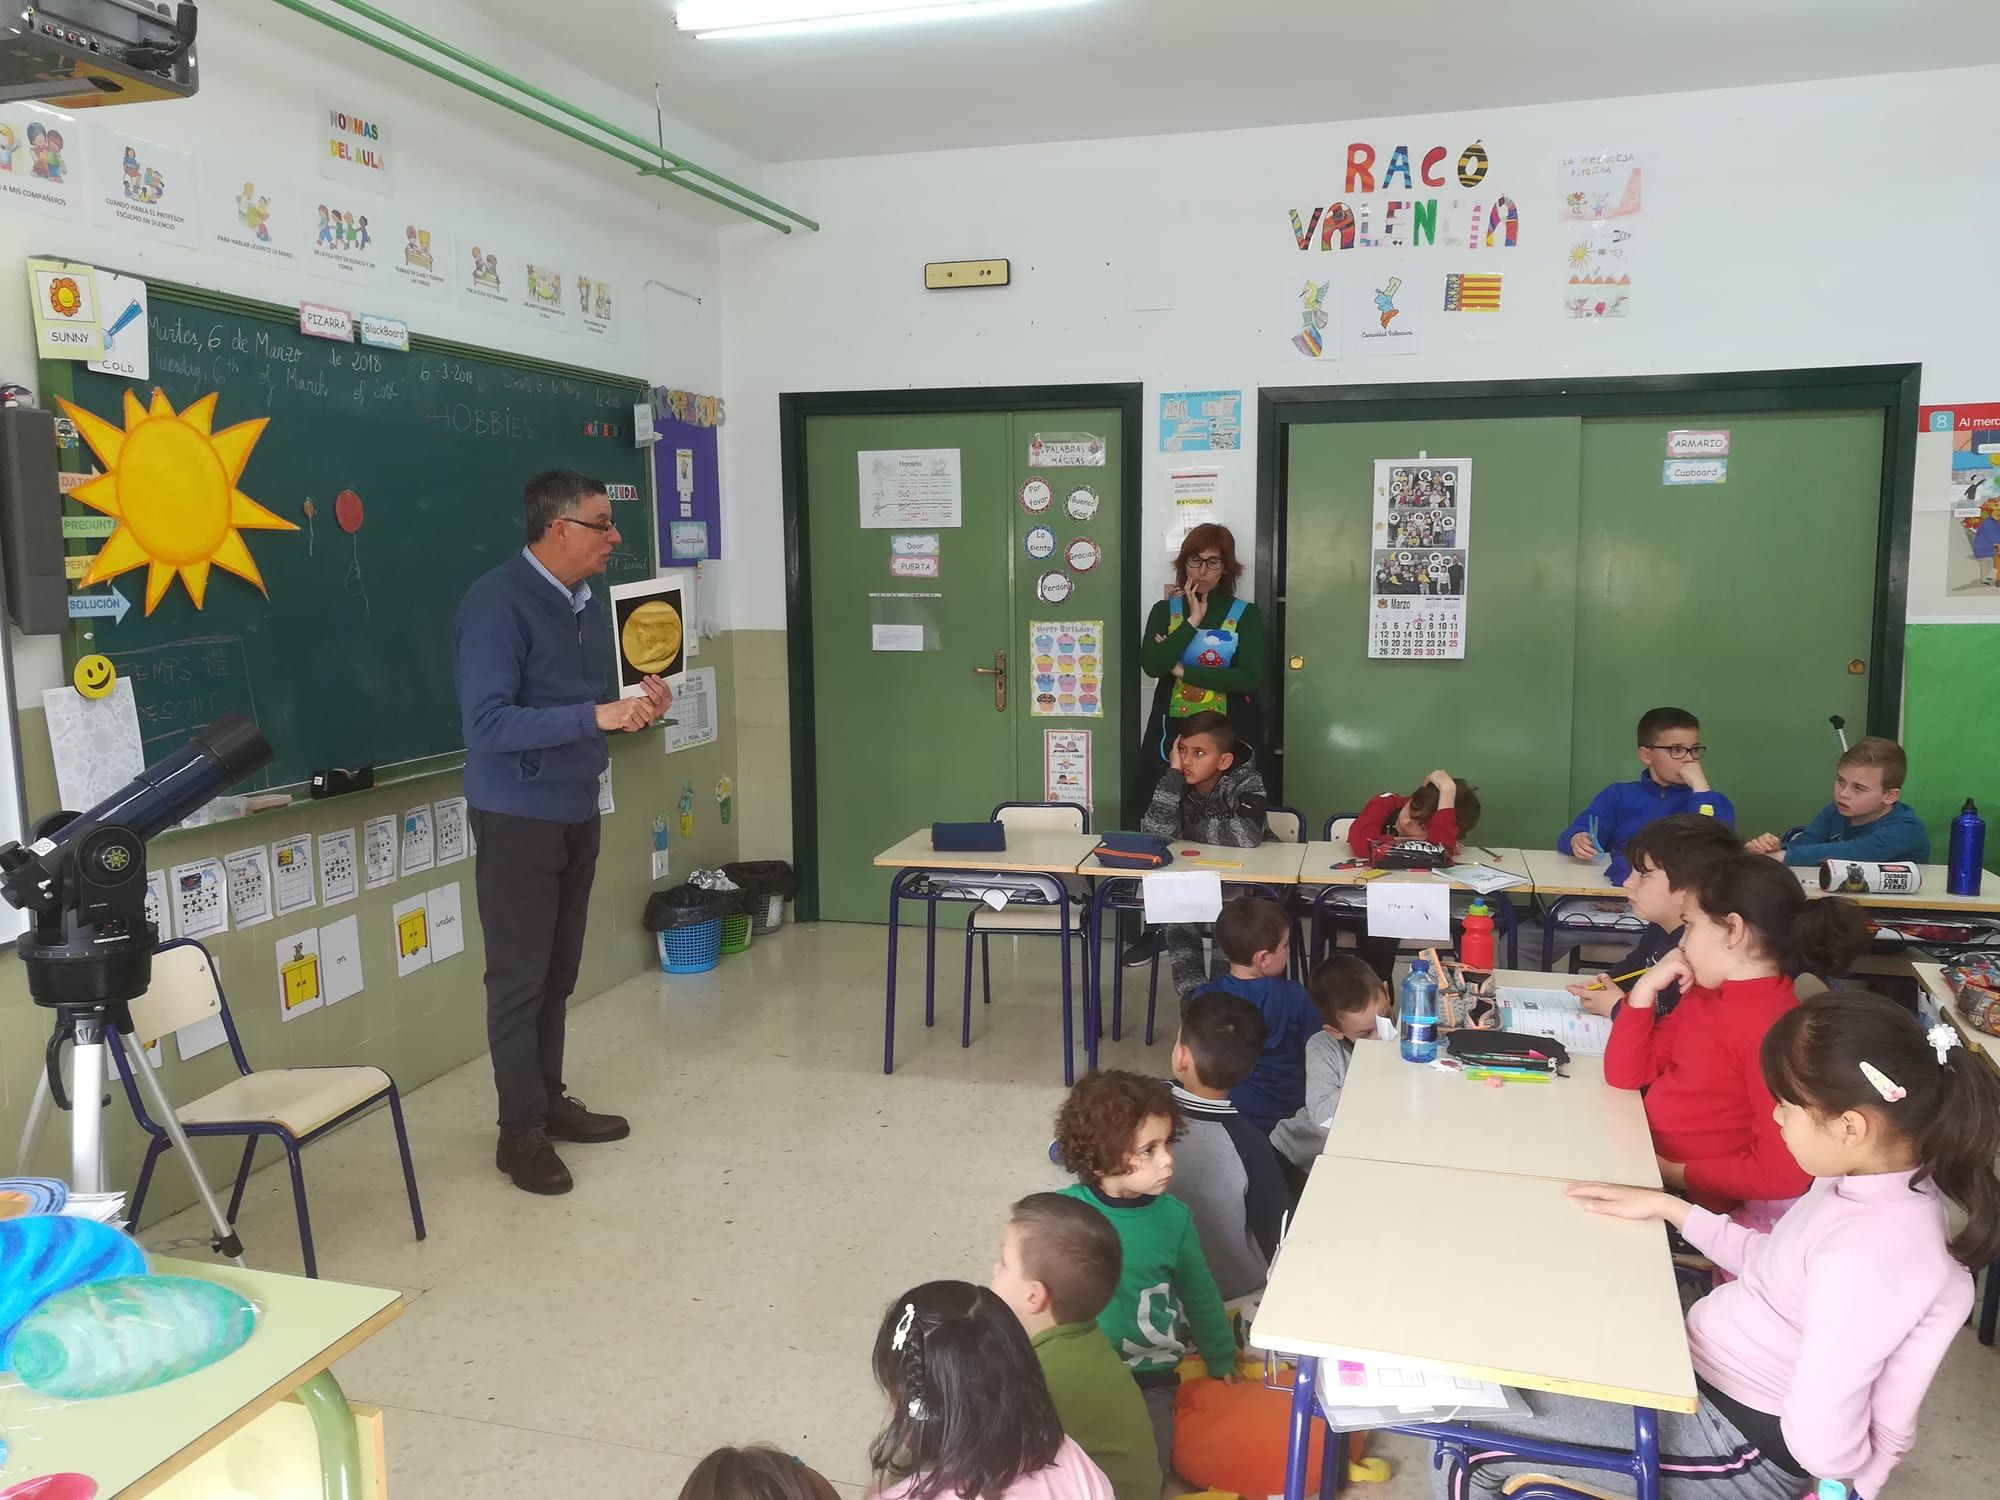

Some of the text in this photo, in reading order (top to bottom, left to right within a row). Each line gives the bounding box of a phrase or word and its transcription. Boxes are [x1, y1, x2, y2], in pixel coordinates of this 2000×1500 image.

[329, 110, 378, 141] NORMAS
[329, 139, 385, 172] DEL AULA
[1345, 138, 1488, 193] RACÓ
[9, 186, 22, 195] MIS
[22, 189, 67, 206] COMPAÑEROS
[105, 197, 130, 210] CUANDO
[130, 203, 149, 215] HABLA
[156, 211, 184, 224] PROFESOR
[116, 210, 175, 231] ESCUCHO EN SILENCIO
[217, 235, 231, 244] PARA
[250, 243, 272, 254] LEVANTO
[307, 312, 346, 330] PIZARRA
[51, 331, 89, 343] SUNNY
[365, 323, 405, 340] BlackBoard
[207, 324, 223, 351] 6
[232, 328, 249, 353] de
[255, 332, 303, 362] Marzo
[351, 351, 382, 373] 2018
[103, 360, 134, 373] COLD
[424, 400, 536, 438] HOBBIES
[1936, 414, 1948, 429] 8
[1958, 417, 1971, 428] Al
[1045, 444, 1086, 454] PALABRAS
[1674, 439, 1723, 449] ARMARIO
[1051, 456, 1085, 465] MÁGICAS
[1674, 467, 1718, 479] Cupboard
[1029, 484, 1041, 493] Por
[1029, 496, 1049, 507] favor
[1036, 531, 1046, 540] Lo
[906, 542, 924, 550] Door
[1029, 543, 1051, 552] siento
[1069, 551, 1096, 561] Gracias
[900, 562, 931, 571] PUERTA
[1043, 583, 1068, 592] Perdón
[69, 598, 120, 611] SOLUCIÓN
[1391, 598, 1411, 610] Marzo
[1036, 625, 1057, 635] Happy
[1382, 622, 1388, 630] 5
[1394, 622, 1399, 630] 6
[1406, 622, 1410, 630] 7
[1438, 622, 1447, 630] 10
[1450, 622, 1458, 630] 11
[1414, 640, 1423, 648] 22
[1426, 640, 1435, 648] 23
[1438, 640, 1446, 648] 24
[1449, 640, 1458, 648] 25
[1379, 648, 1446, 656] 26 27 28 29 30 31
[435, 915, 456, 928] under
[335, 956, 347, 965] on
